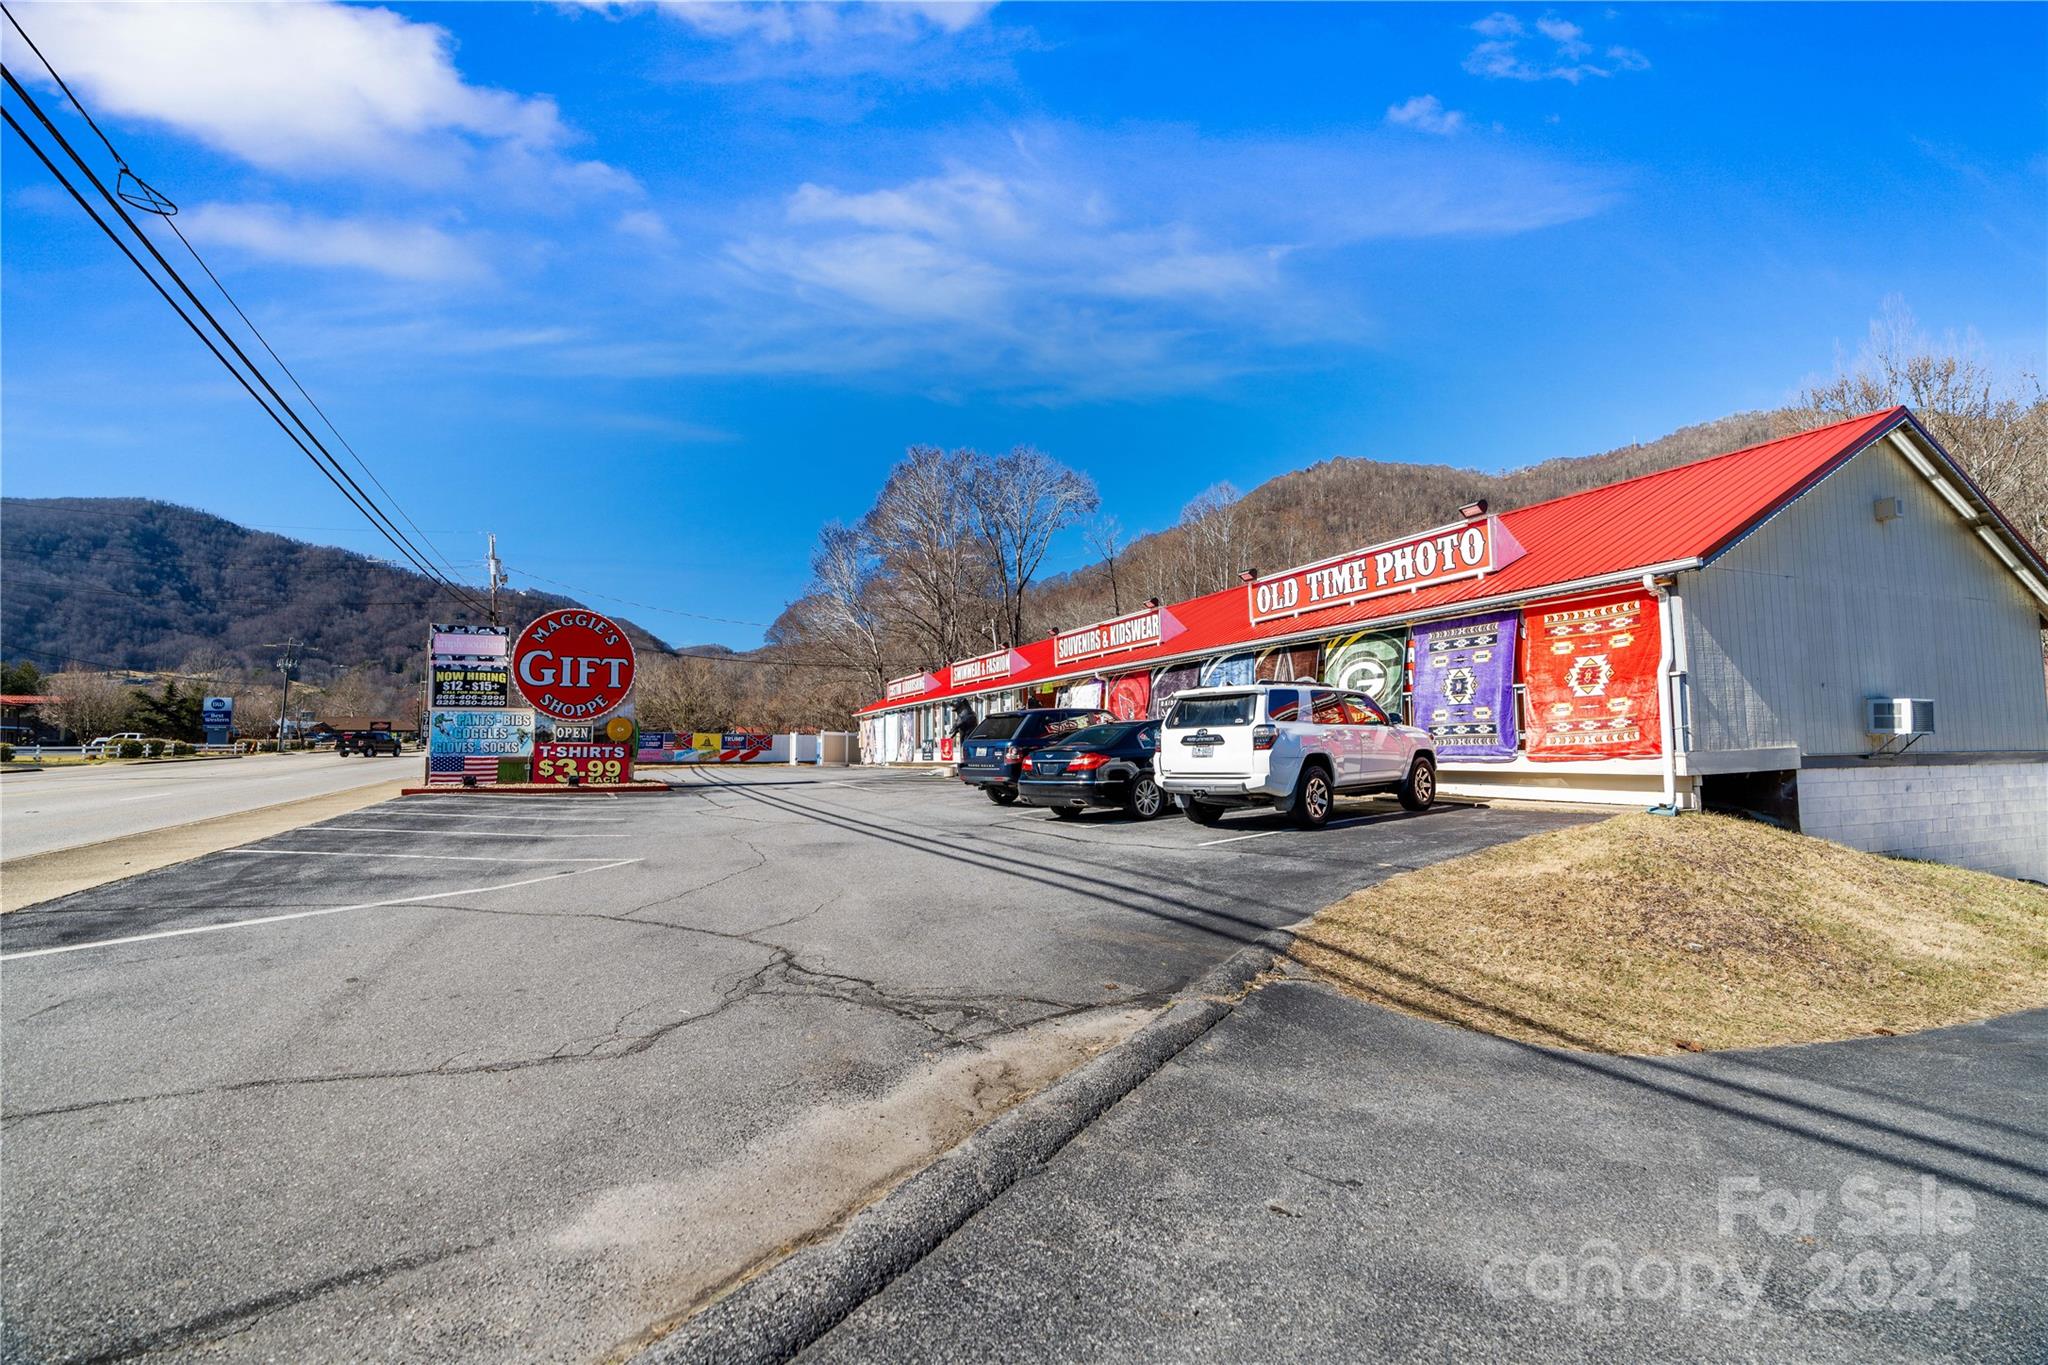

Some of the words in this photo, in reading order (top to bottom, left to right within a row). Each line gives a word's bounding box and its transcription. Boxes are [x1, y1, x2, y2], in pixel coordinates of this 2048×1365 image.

[1256, 577, 1299, 614] OLD
[1306, 558, 1367, 602] TIME
[1375, 527, 1486, 587] PHOTO
[531, 613, 620, 645] MAGGIE'S
[1058, 629, 1101, 658] SOUVENIRS
[1102, 630, 1109, 648] &
[1110, 614, 1159, 646] KIDSWEAR
[519, 650, 629, 688] GIFT
[953, 661, 981, 681] SWIMWEAR
[986, 654, 1010, 675] FASHION
[436, 671, 465, 682] NOW
[466, 672, 507, 684] HIRING
[442, 681, 463, 691] $12
[472, 681, 500, 691] $15+
[540, 693, 609, 717] SHOPPE
[456, 713, 494, 726] PANTS
[503, 714, 531, 727] BIBS
[453, 727, 509, 739] GOGGLES
[556, 727, 589, 738] OPEN
[435, 742, 475, 753] GLOVES
[483, 742, 519, 753] SOCKS
[539, 746, 625, 758] T-SHIRTS
[538, 758, 622, 783] $3.99
